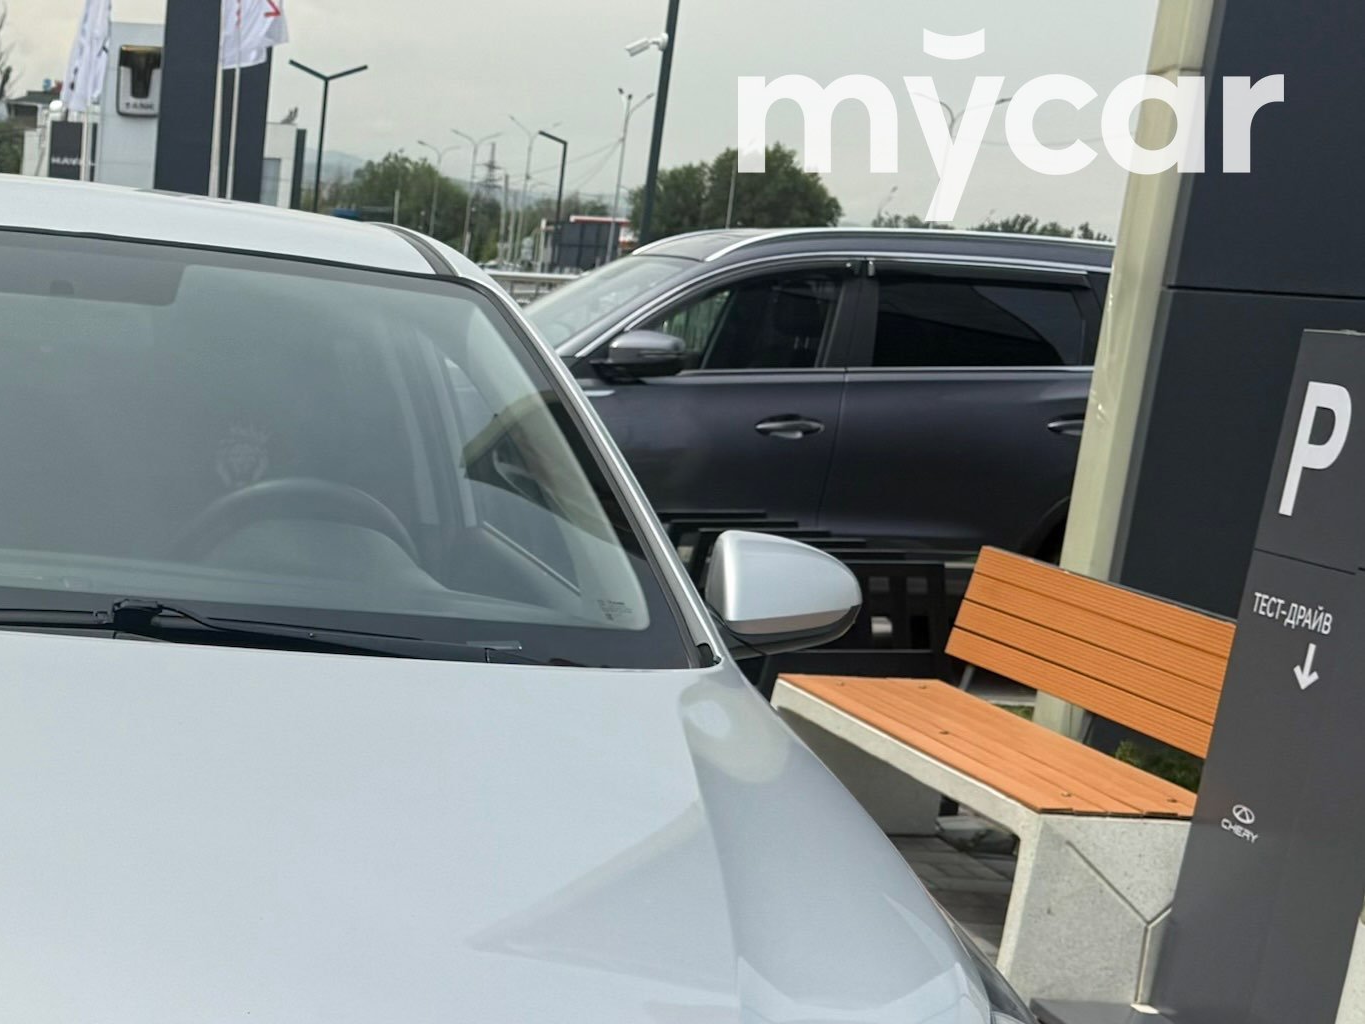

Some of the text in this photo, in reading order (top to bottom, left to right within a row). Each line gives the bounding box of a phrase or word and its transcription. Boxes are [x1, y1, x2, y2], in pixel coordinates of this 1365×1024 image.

[50, 156, 98, 167] HAVL
[1278, 380, 1352, 517] P
[1253, 591, 1333, 635] ТЕСТ-ДРАЙВ
[1221, 817, 1259, 844] CHERY
